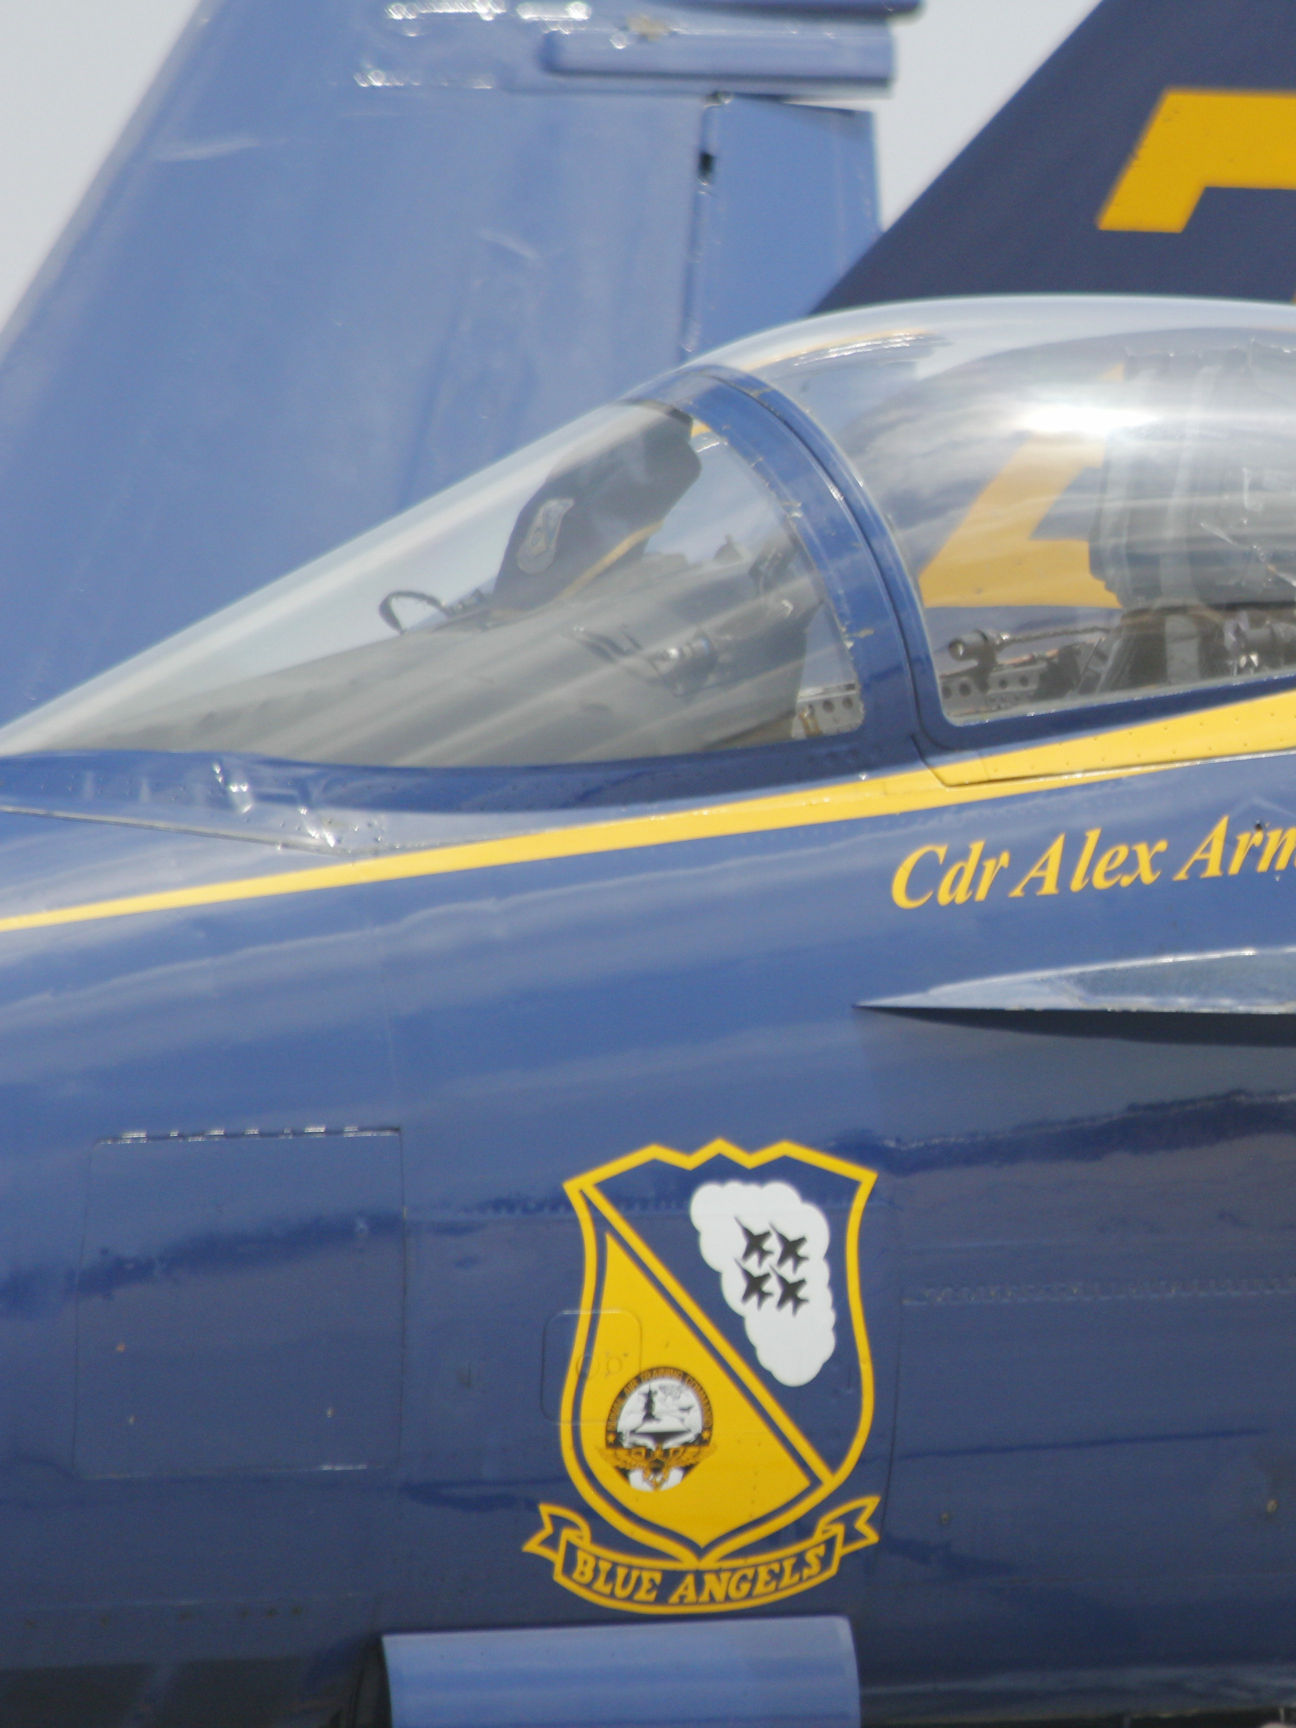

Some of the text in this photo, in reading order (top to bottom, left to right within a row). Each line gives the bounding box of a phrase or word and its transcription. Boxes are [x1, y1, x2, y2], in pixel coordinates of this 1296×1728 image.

[892, 841, 1009, 909] Cdr
[1008, 828, 1168, 897] Alex
[572, 1543, 827, 1605] BLUE ANGELS
